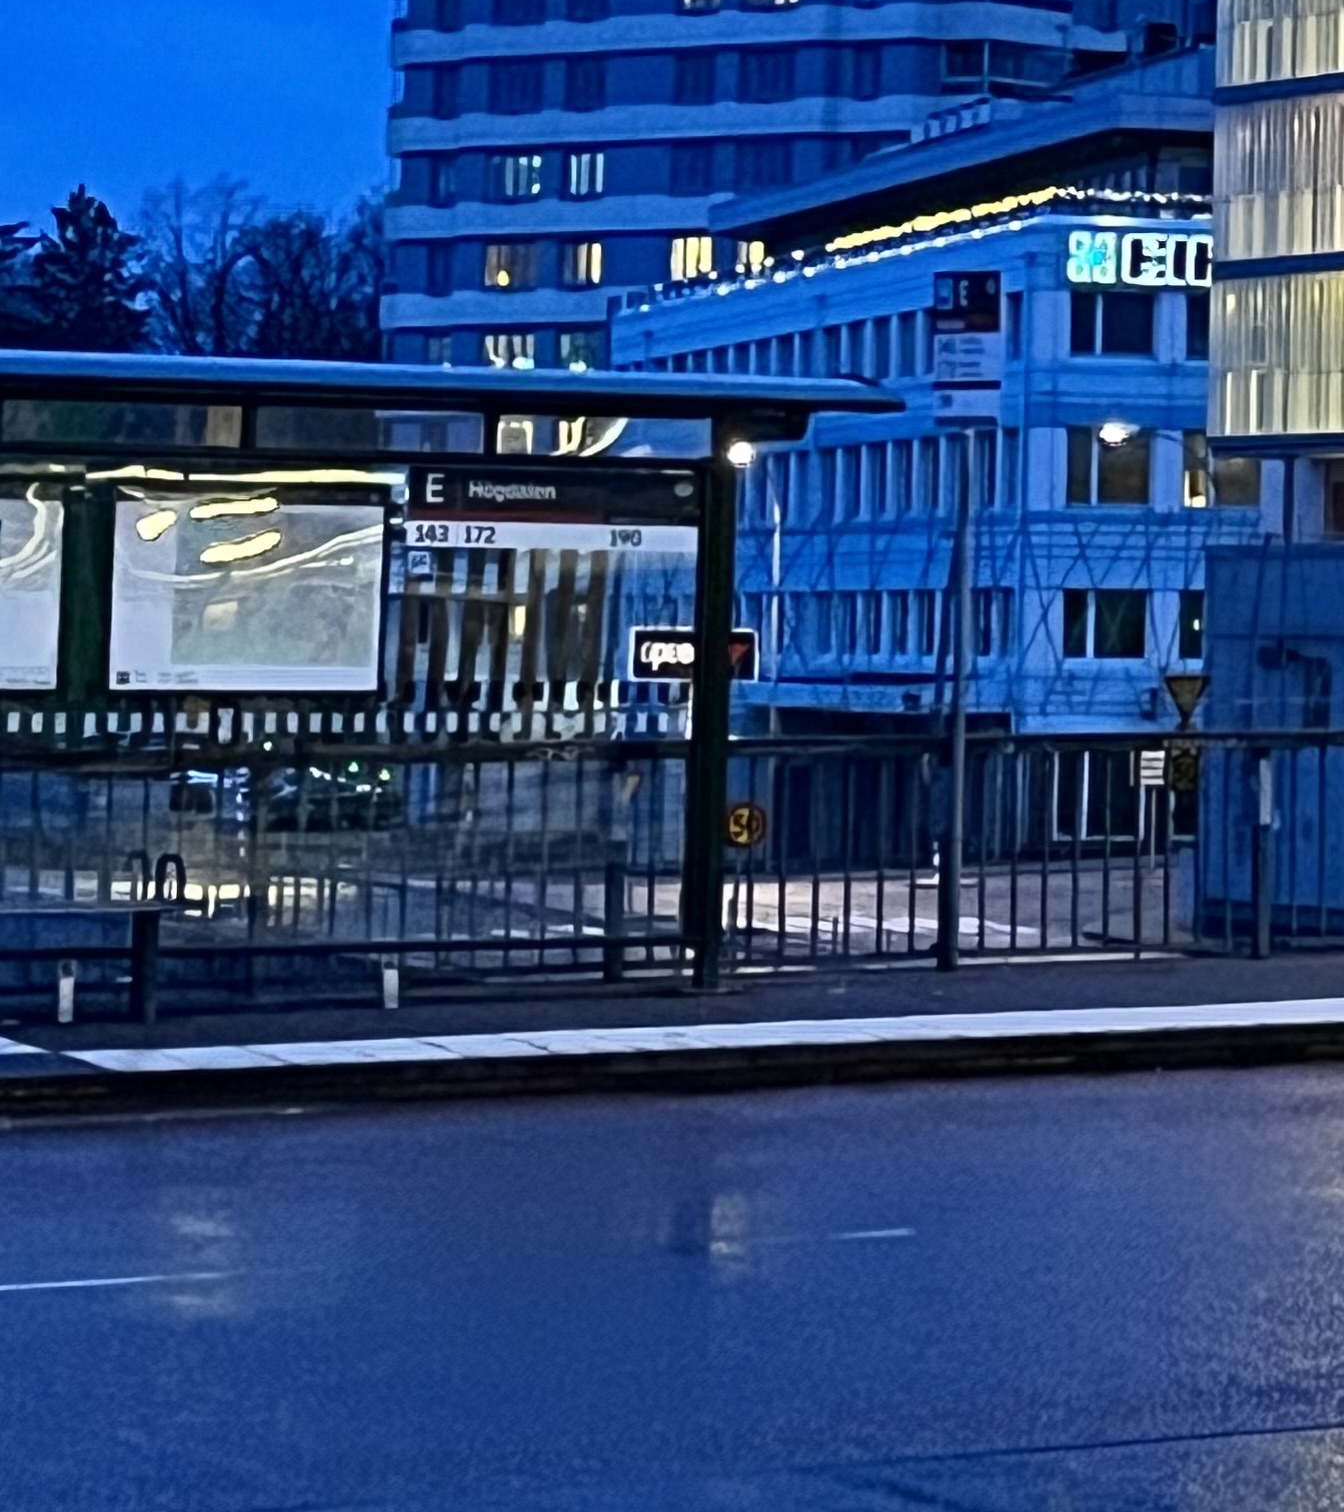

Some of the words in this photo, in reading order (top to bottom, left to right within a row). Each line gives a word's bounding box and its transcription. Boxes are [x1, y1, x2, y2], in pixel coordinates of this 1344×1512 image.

[425, 473, 446, 503] E
[414, 523, 450, 543] 143
[463, 524, 497, 544] 172
[609, 529, 642, 547] 190
